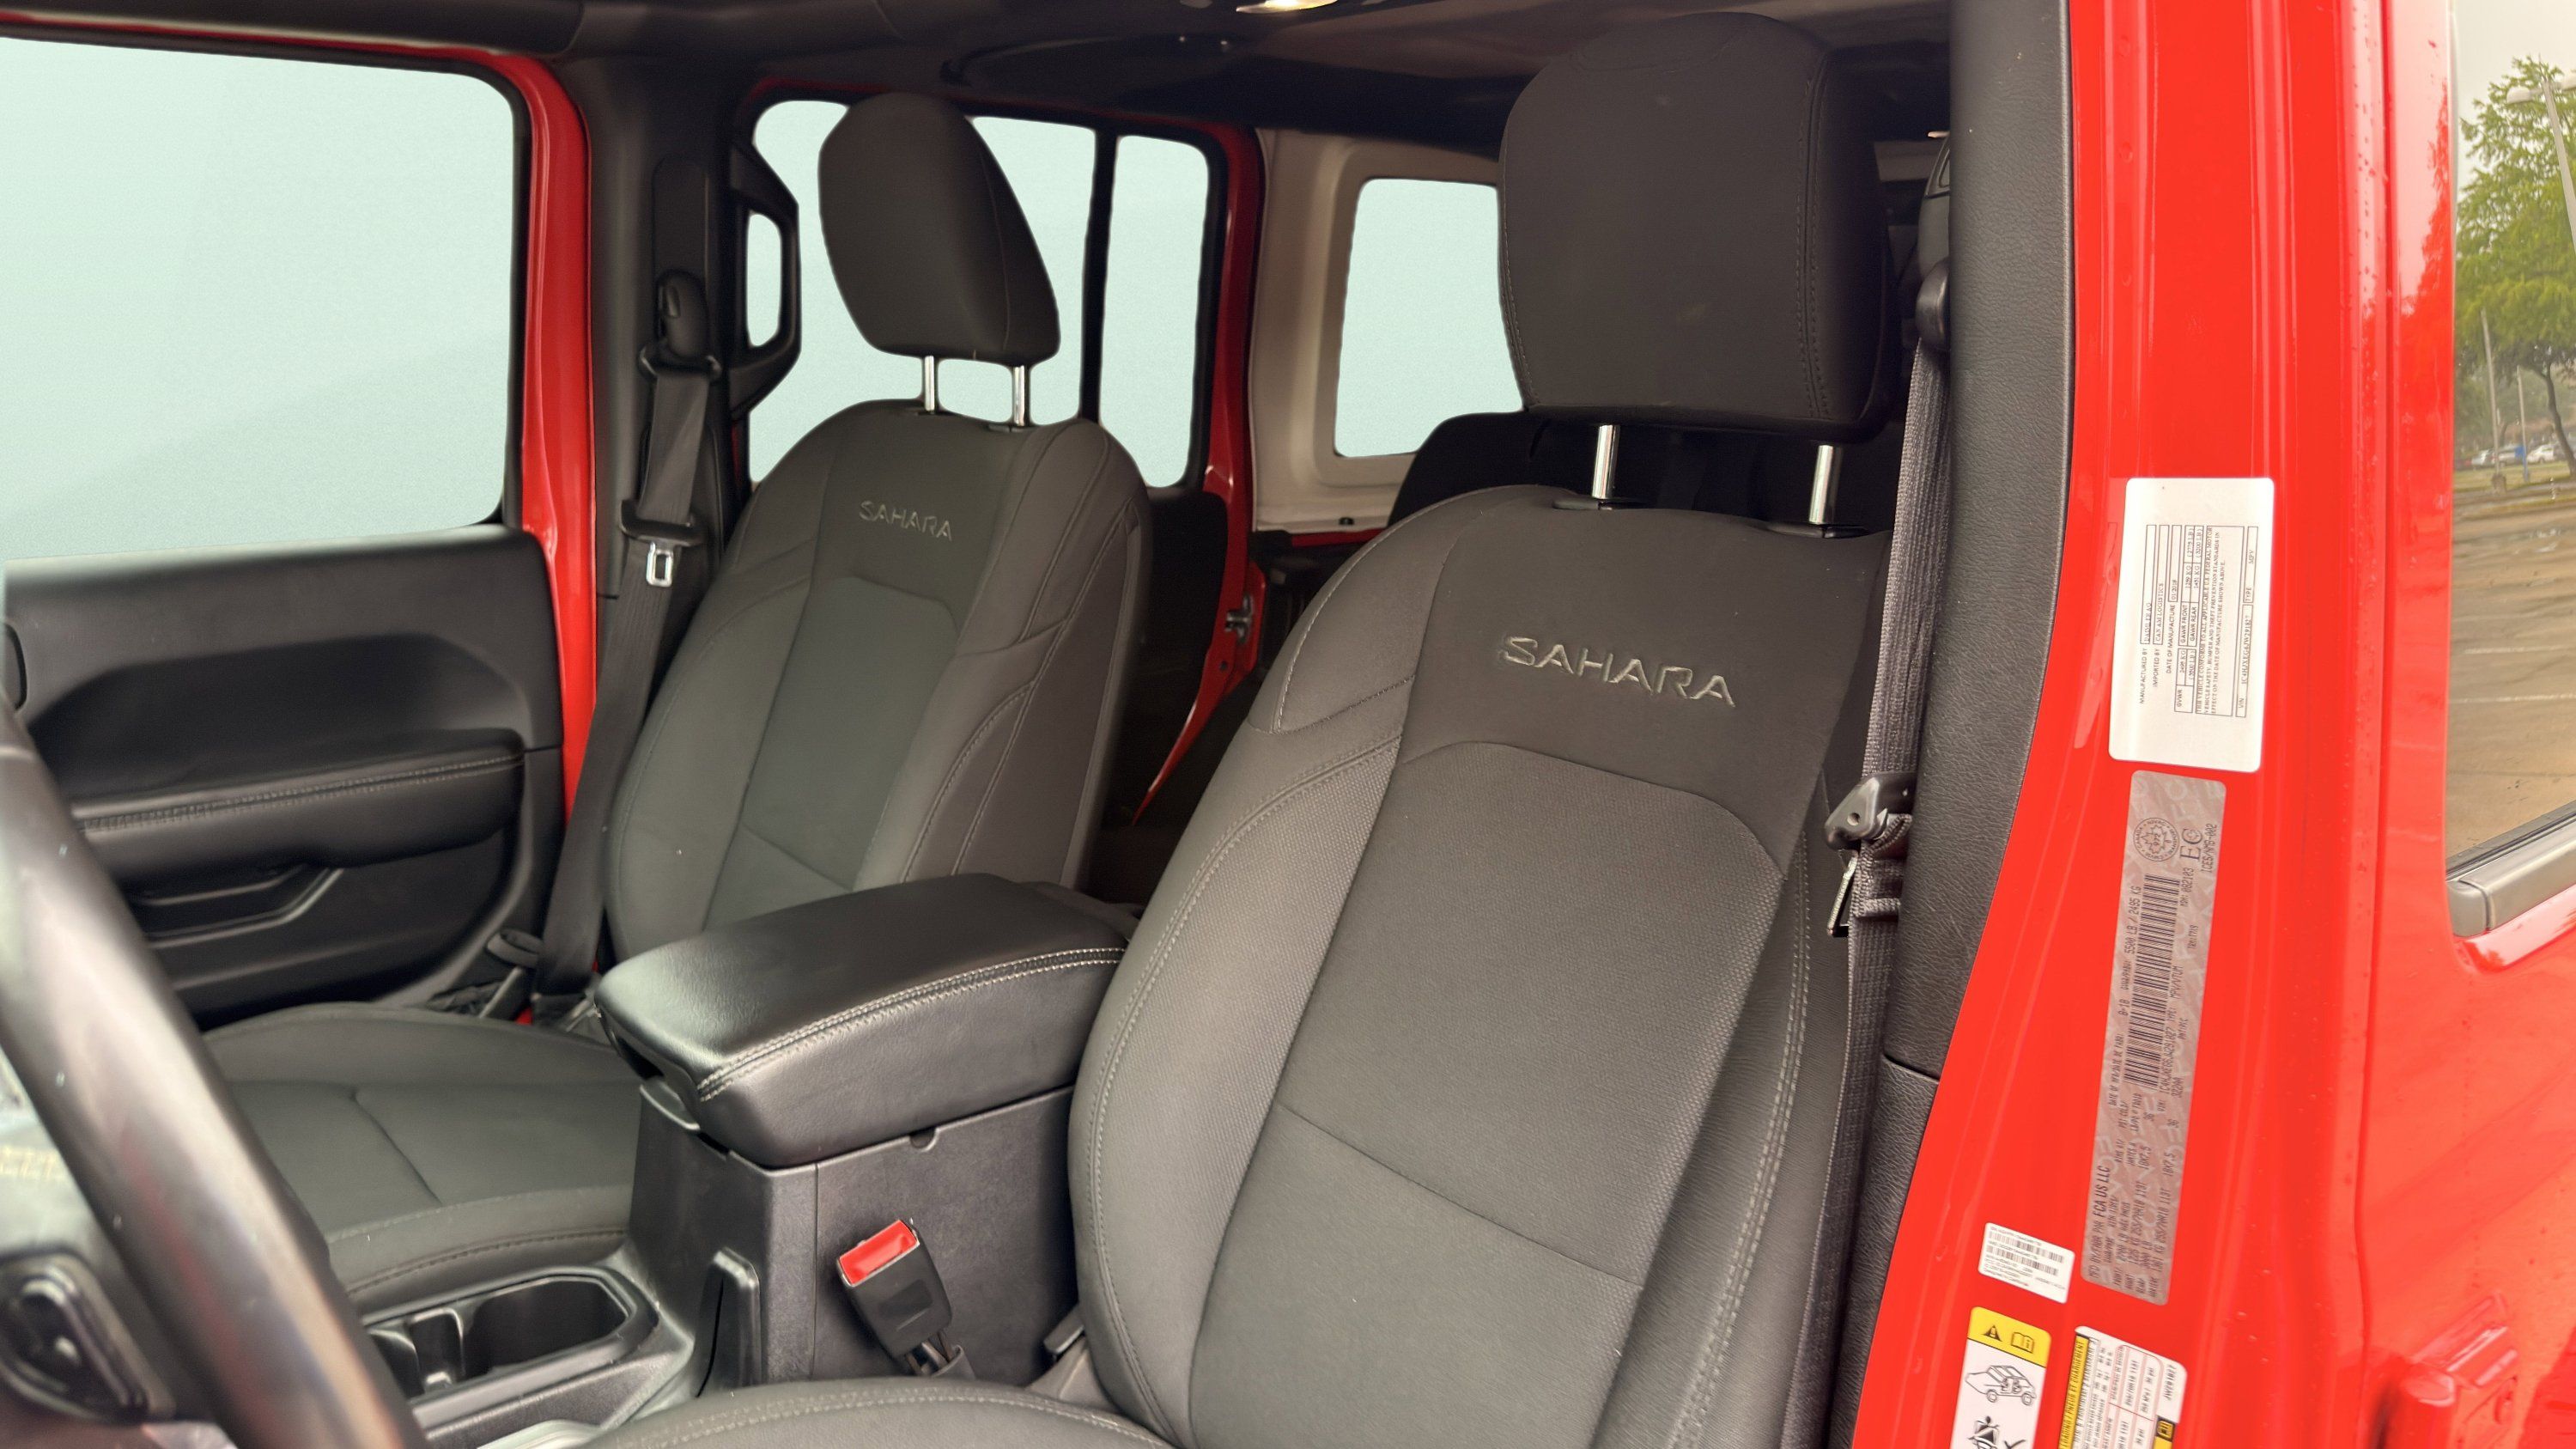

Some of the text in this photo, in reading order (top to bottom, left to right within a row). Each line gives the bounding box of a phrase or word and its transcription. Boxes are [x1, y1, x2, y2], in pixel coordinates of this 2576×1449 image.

[860, 501, 952, 541] SAHARA
[2185, 565, 2191, 574] KG
[2194, 565, 2200, 575] KG
[2180, 650, 2185, 659] KG
[1501, 636, 1735, 708] SAHARA
[2201, 823, 2217, 873] ICES/NMB-002
[2130, 885, 2141, 894] KG
[2126, 925, 2137, 934] LB
[2124, 936, 2136, 953] 5500
[2096, 1165, 2109, 1183] LLC
[2094, 1183, 2107, 1197] US
[2093, 1198, 2105, 1217] FCA
[2071, 1340, 2084, 1383] CHARGEMENT
